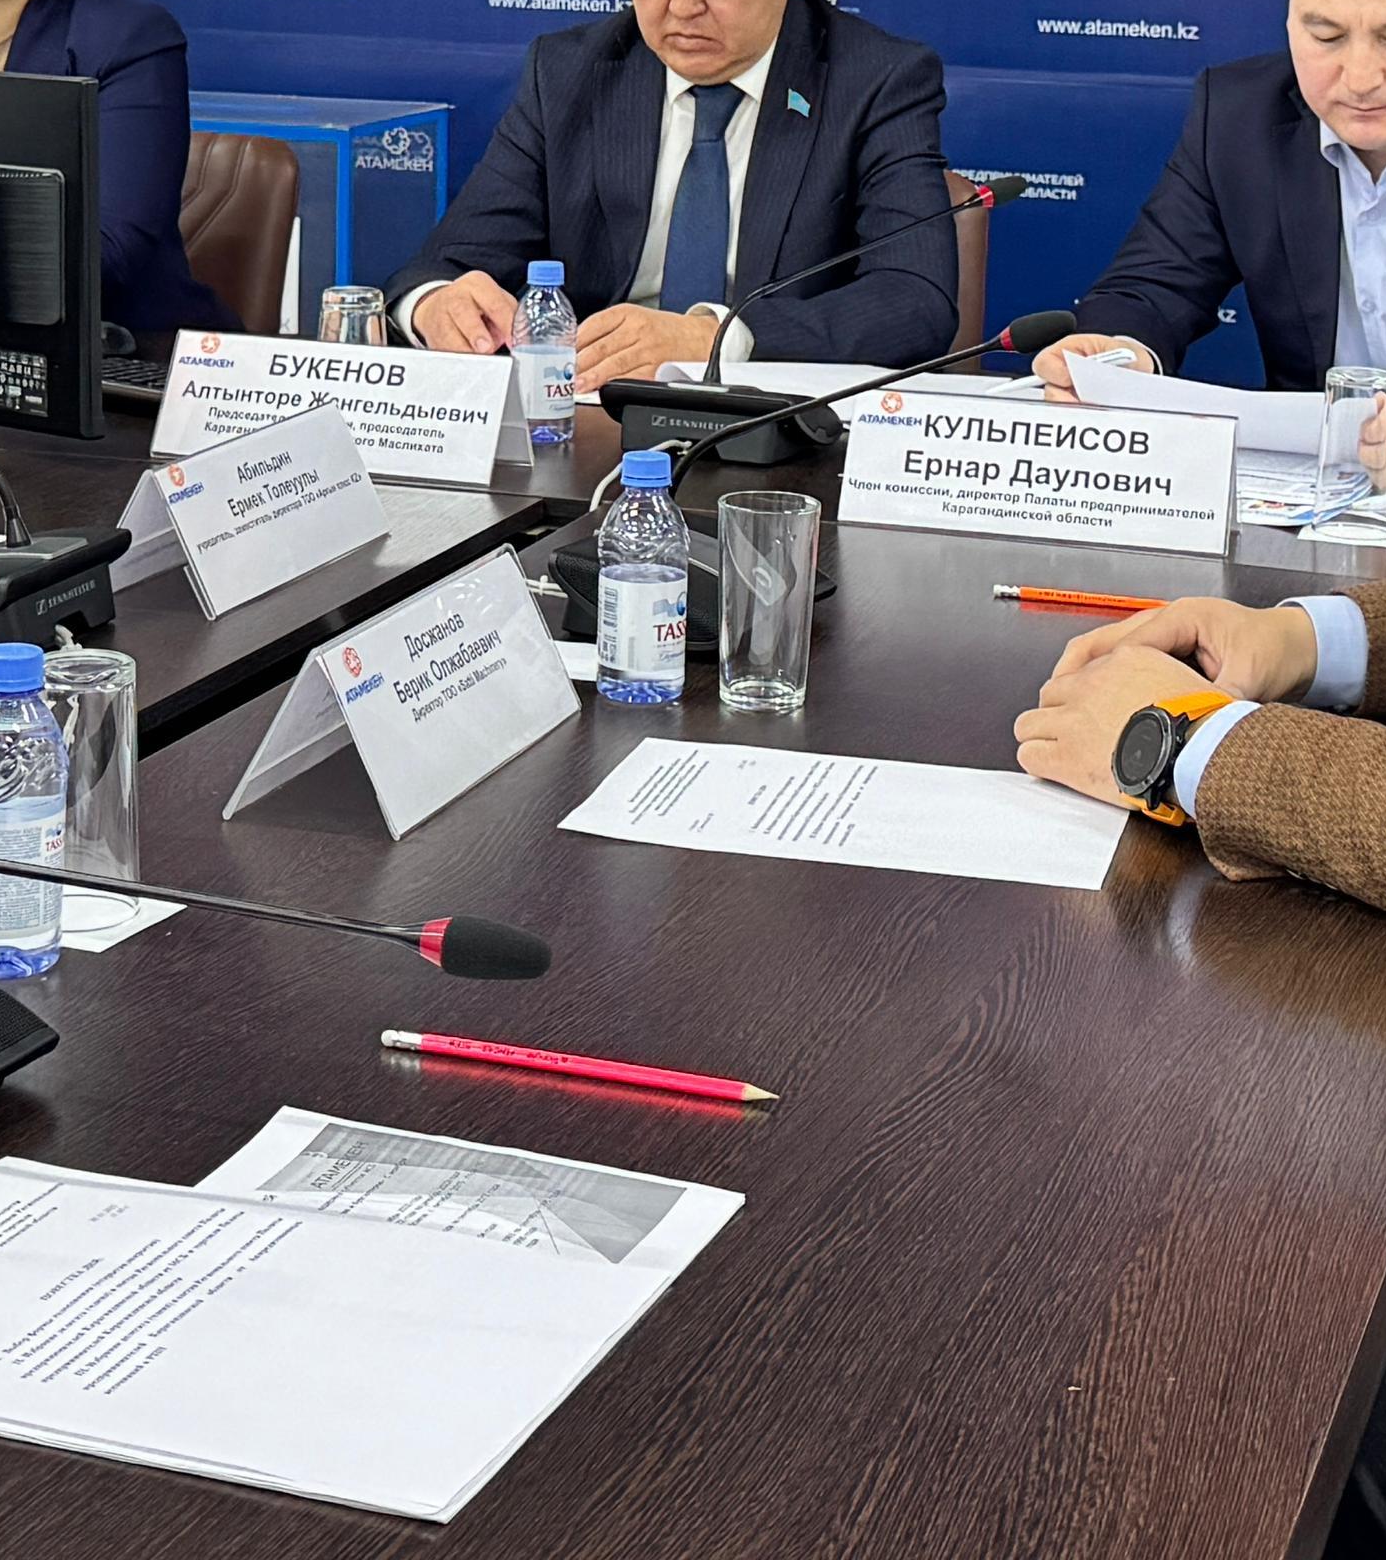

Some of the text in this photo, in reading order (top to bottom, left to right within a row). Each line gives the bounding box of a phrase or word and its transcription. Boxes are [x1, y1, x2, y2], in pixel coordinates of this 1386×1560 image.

[1038, 20, 1199, 39] www.atameken.kz
[1020, 187, 1077, 200] БЛАСТИ
[268, 353, 406, 387] БУКЕНОВ
[182, 379, 489, 425] Алтынторе Жнгельдыевич
[208, 406, 287, 423] Председател
[858, 413, 923, 427] АТАМЕКЕН
[924, 413, 1150, 455] КУЛЬПЕИСОВ
[236, 450, 293, 485] Абильдин
[904, 449, 1172, 497] Ернар Даулович
[227, 492, 266, 518] Ермек
[263, 468, 320, 503] Толеуулы
[848, 477, 1215, 521] Член комиссии, директор Палаты предпринимателей
[942, 501, 1113, 527] Карагандинской области
[404, 612, 465, 663] Досжанов
[393, 629, 502, 705] Берик Олжабаевич
